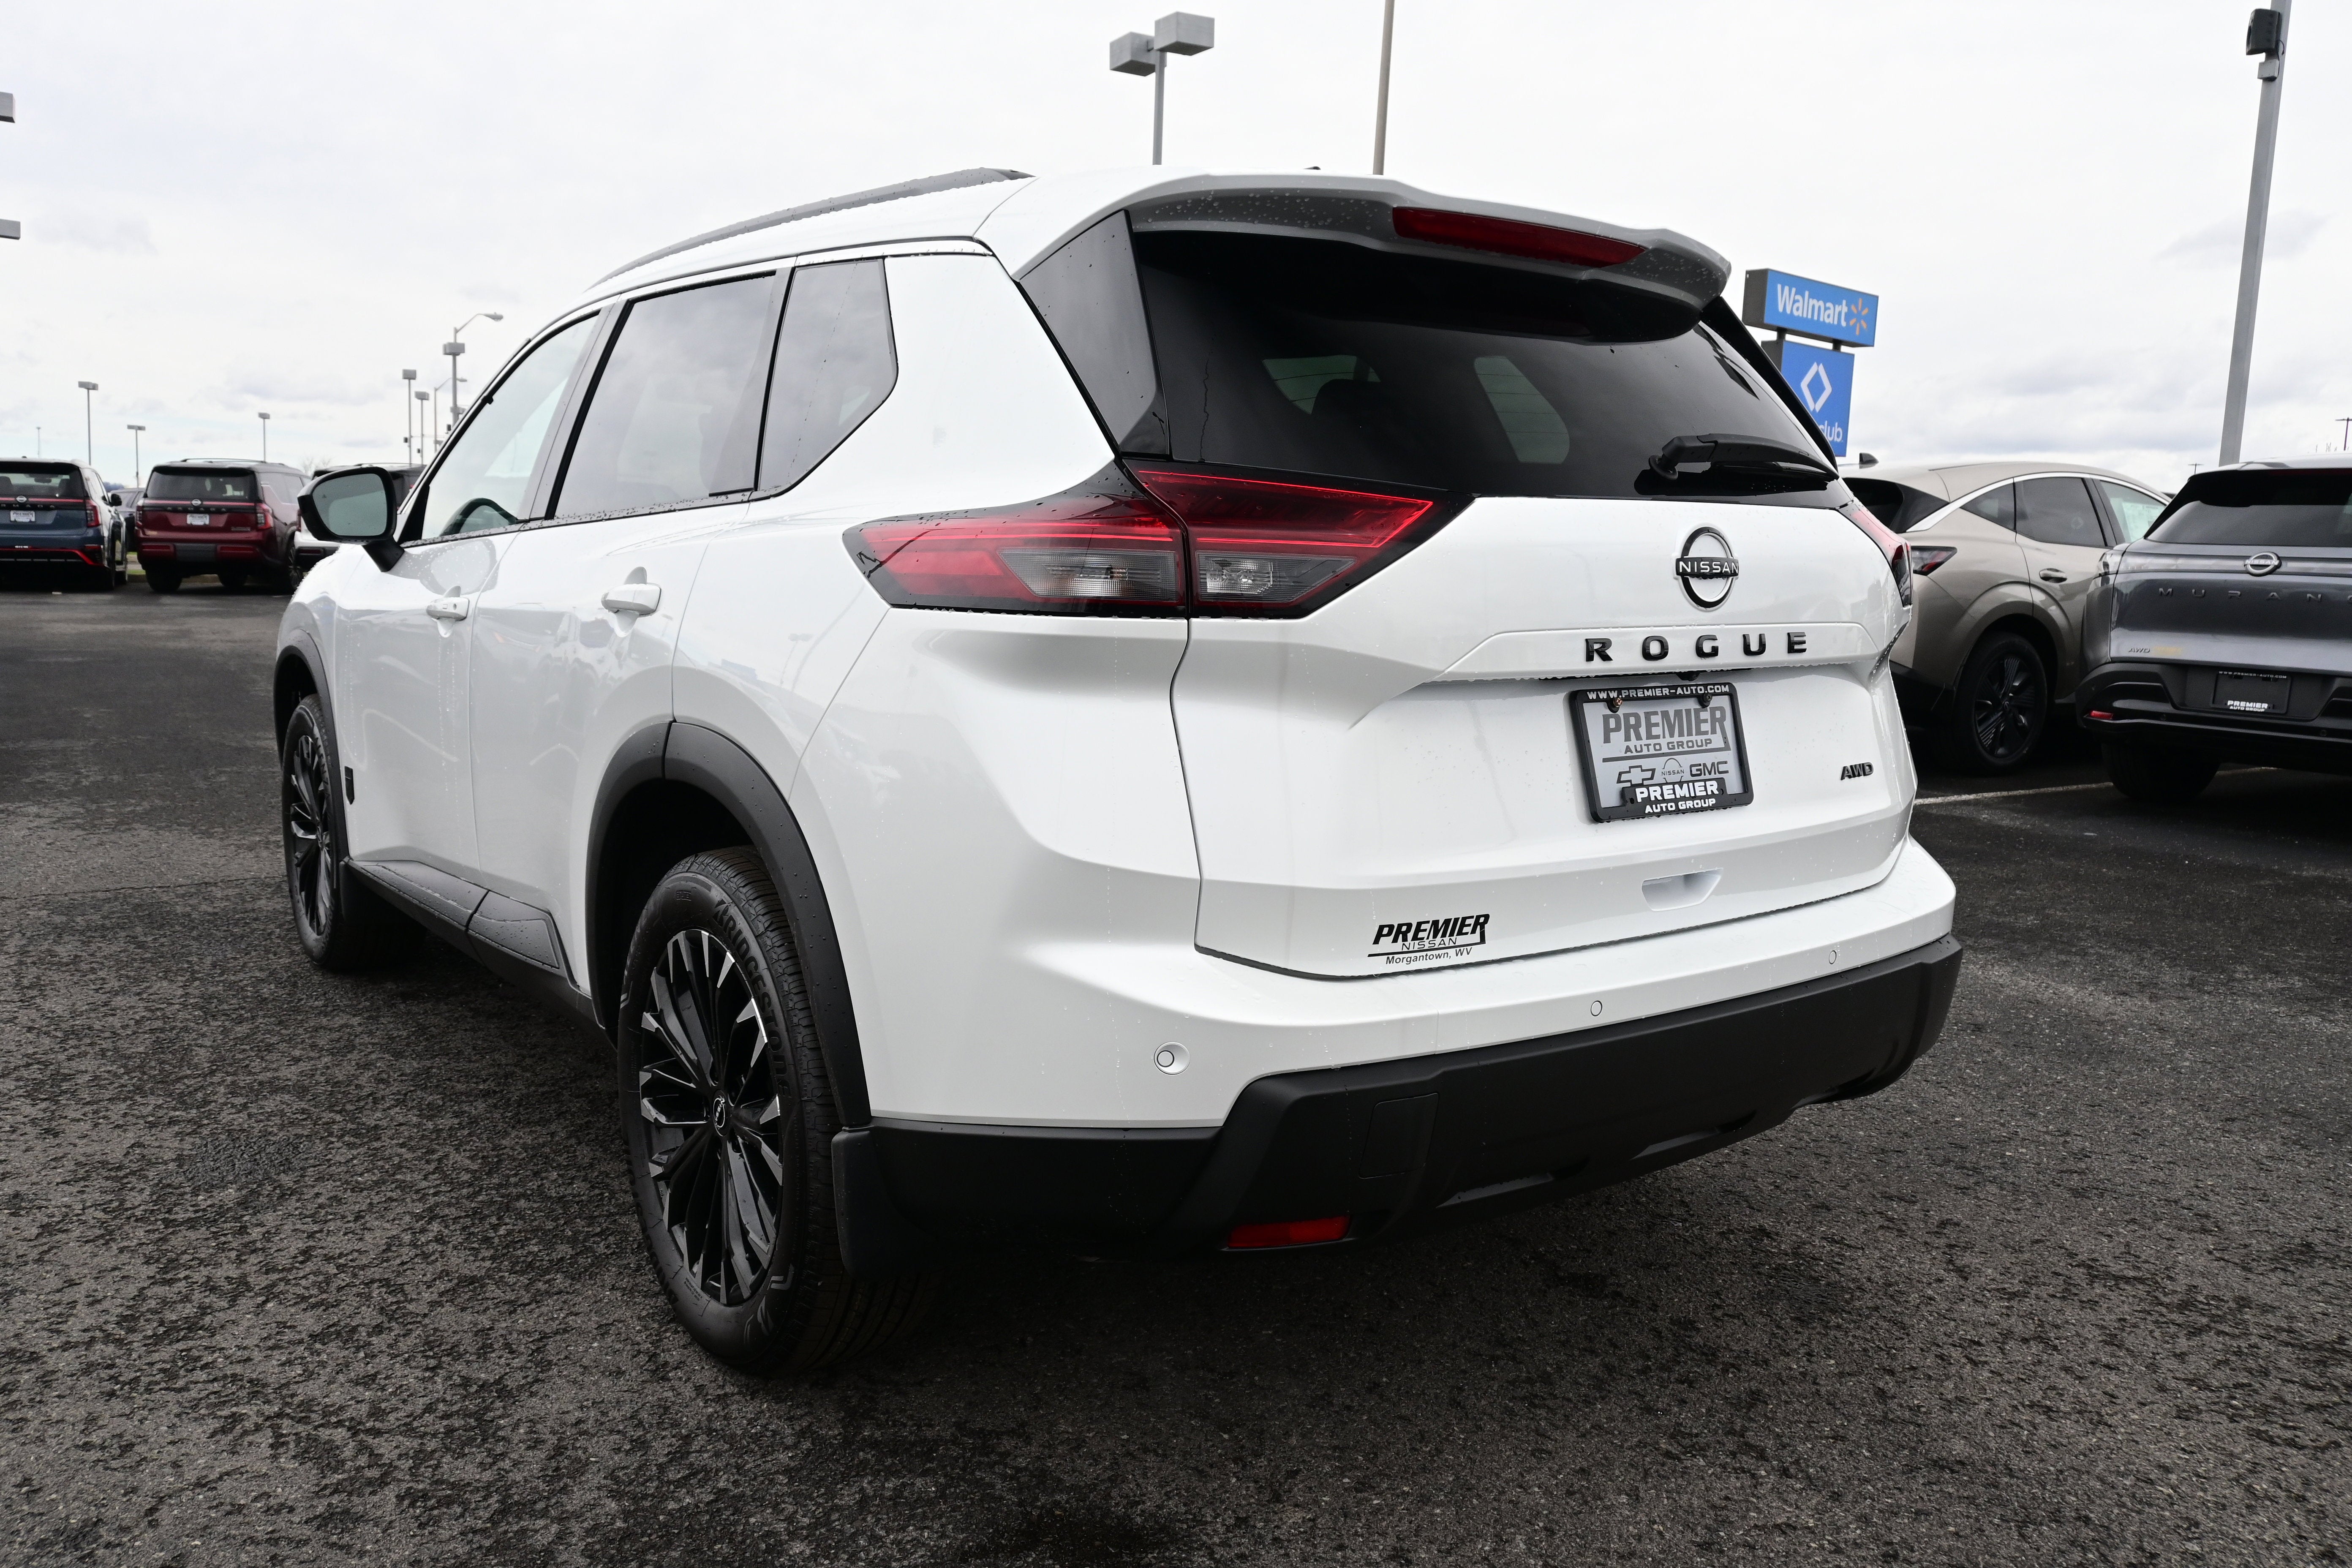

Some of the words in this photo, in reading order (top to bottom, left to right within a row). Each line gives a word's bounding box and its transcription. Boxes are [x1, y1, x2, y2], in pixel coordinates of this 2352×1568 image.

[1777, 283, 1848, 327] Walmart
[1679, 561, 1739, 574] NISSAN
[1585, 632, 1807, 662] ROGUE
[1587, 685, 1729, 699] WWW.PREMIER-AUTO.COM
[2227, 700, 2268, 709] PREMIER
[1602, 706, 1731, 748] PREMIER
[1624, 743, 1662, 754] AUTO
[1667, 738, 1712, 750] GROUP
[1689, 761, 1729, 777] GMC
[1840, 762, 1874, 780] AWD
[1635, 780, 1719, 802] PREMIER
[1645, 801, 1675, 813] AUTO
[1679, 798, 1715, 810] GROUP
[1372, 914, 1490, 945] PREMIER
[1402, 937, 1457, 950] NISSAN
[1386, 952, 1451, 965] Morgantown,
[1455, 947, 1472, 957] WV
